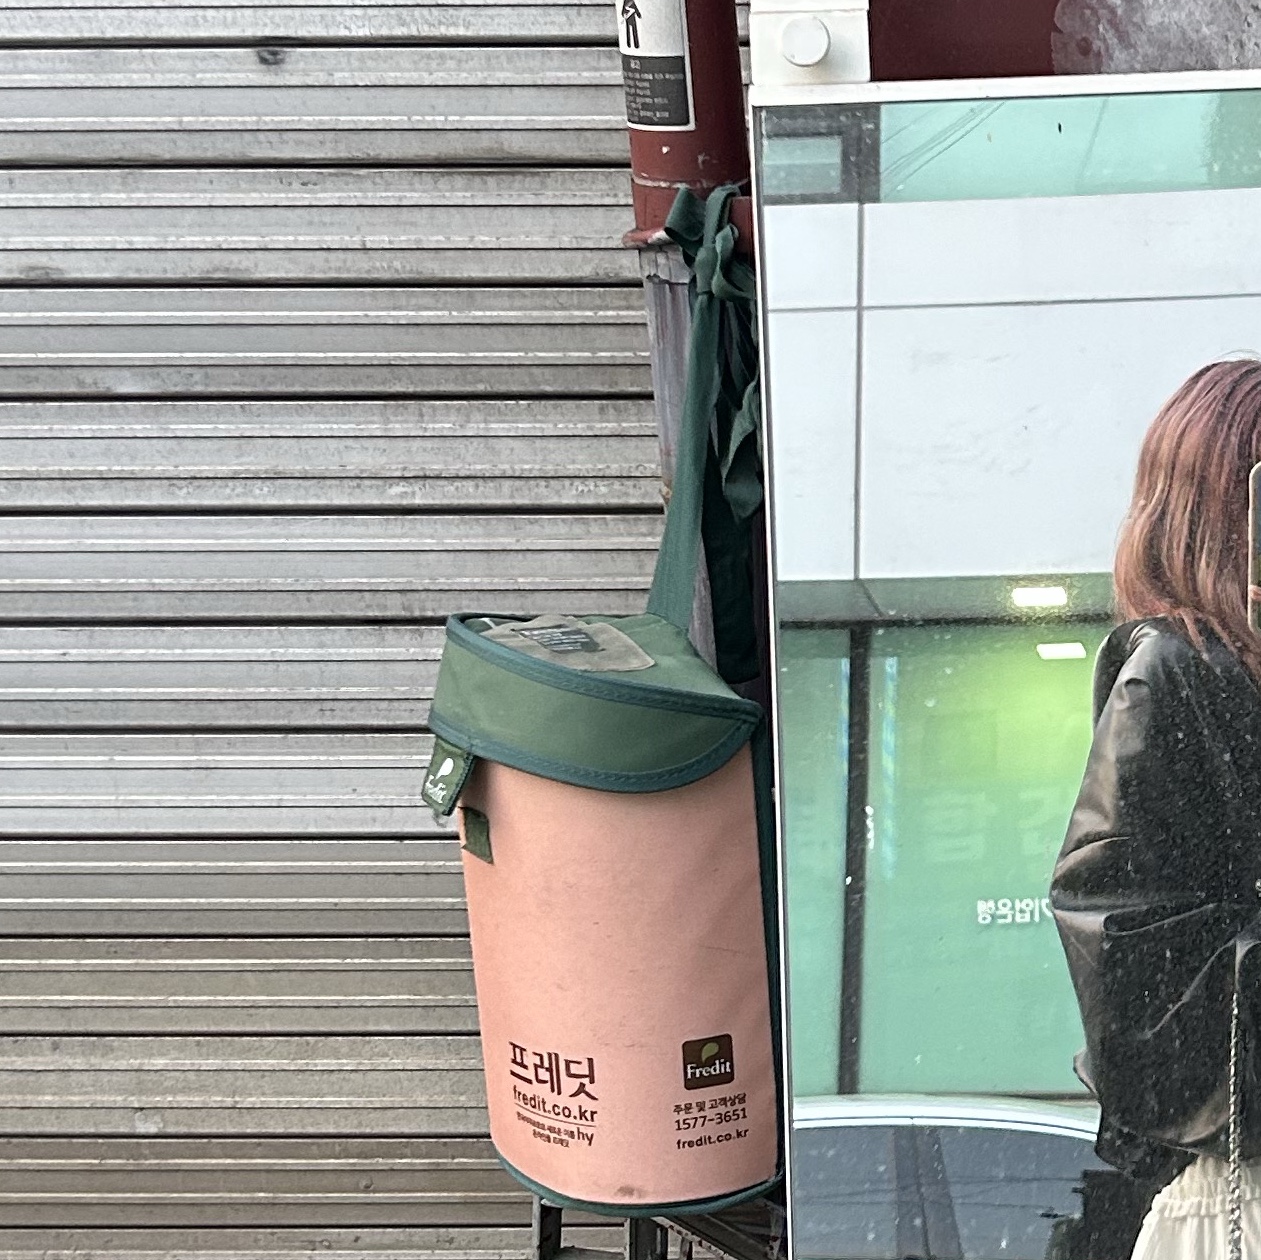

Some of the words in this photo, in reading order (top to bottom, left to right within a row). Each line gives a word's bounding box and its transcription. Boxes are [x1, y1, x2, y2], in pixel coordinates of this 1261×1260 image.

[508, 1041, 599, 1102] 프레딧
[686, 1058, 732, 1080] Fredit
[512, 1086, 598, 1123] fredit.co.kr
[673, 1102, 693, 1116] 주문
[696, 1100, 706, 1113] 및
[708, 1092, 747, 1110] 고객상담
[675, 1107, 748, 1131] 1577-3651
[577, 1127, 594, 1146] hy
[676, 1128, 750, 1150] fredit.co.kr
